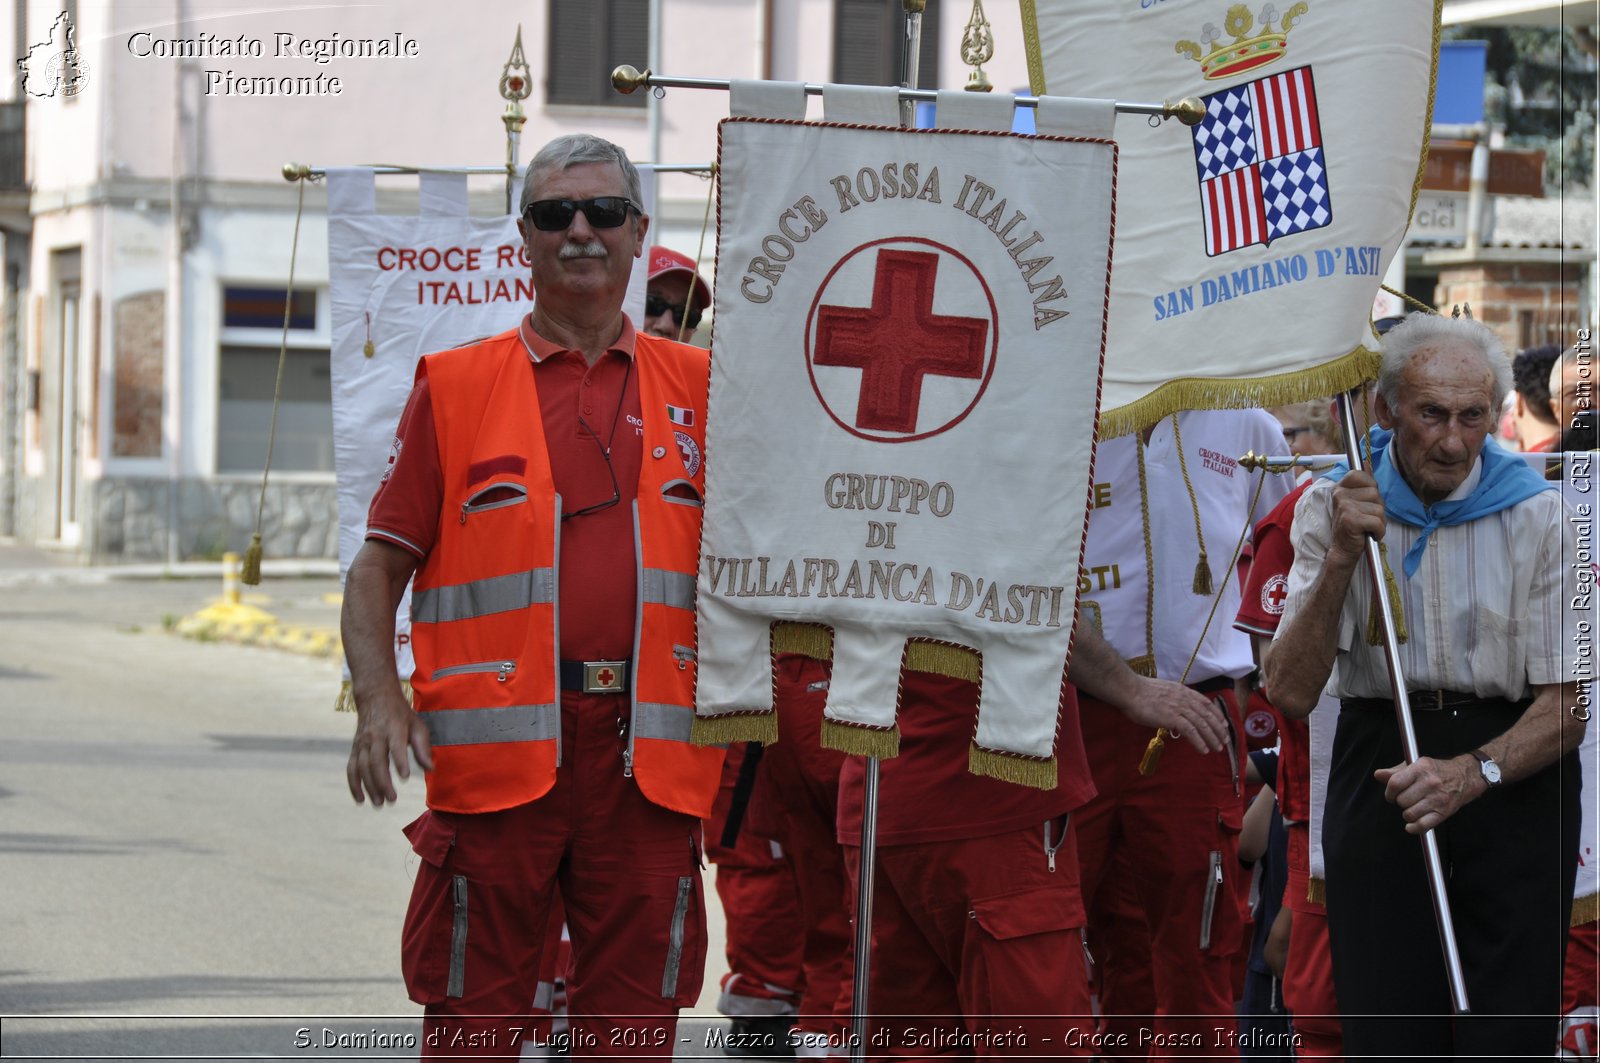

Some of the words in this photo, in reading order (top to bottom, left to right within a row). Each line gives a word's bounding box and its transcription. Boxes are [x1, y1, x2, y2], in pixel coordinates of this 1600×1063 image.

[377, 246, 481, 271] CROCE
[740, 195, 828, 304] CROCE
[829, 162, 942, 214] ROSSA
[952, 174, 1070, 331] ITALIANA
[418, 278, 534, 305] ITALIAN
[1153, 286, 1194, 321] SAN
[1200, 254, 1308, 307] DAMIANO
[626, 414, 643, 427] CRO
[824, 472, 954, 518] GRUPPO
[865, 521, 897, 549] DI
[706, 555, 937, 606] VILLAFRANCA
[944, 571, 1064, 628] D'ASTI
